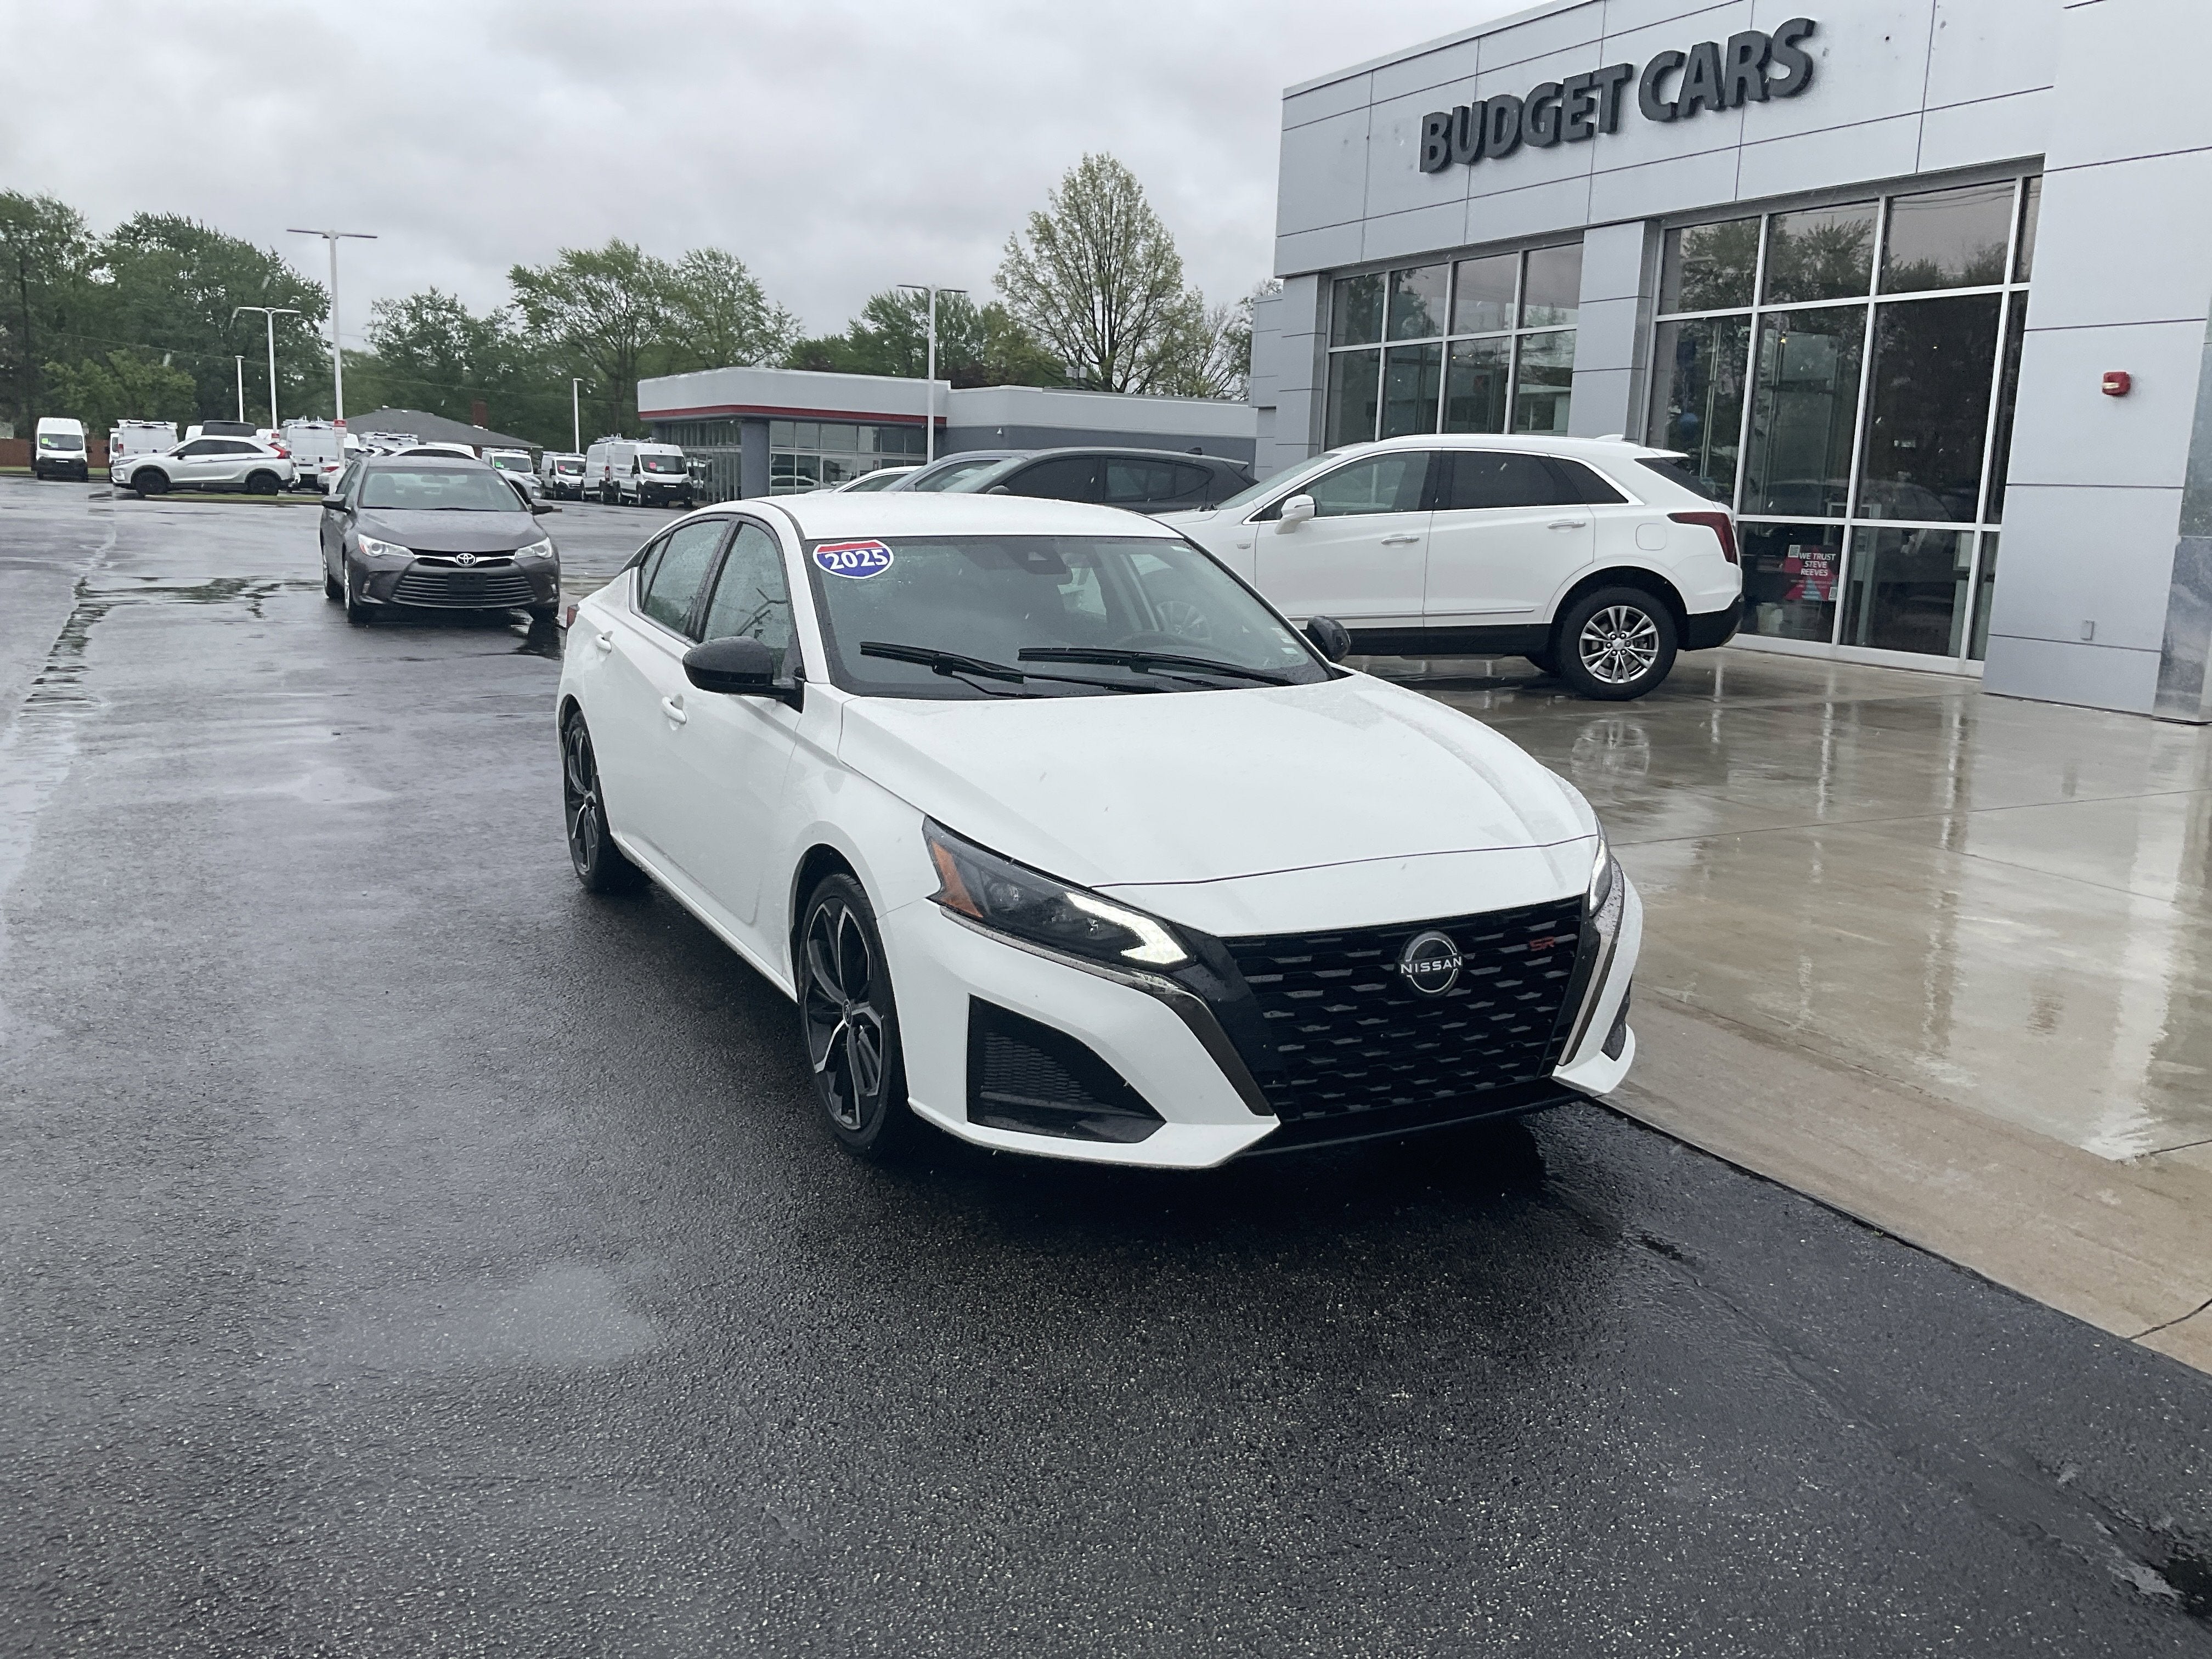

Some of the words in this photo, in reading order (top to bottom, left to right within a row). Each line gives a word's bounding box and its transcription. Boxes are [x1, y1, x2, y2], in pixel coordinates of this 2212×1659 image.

[1419, 63, 1633, 173] BUDGET
[1638, 17, 1816, 122] CARS
[825, 549, 888, 570] 2025
[1400, 956, 1463, 975] NISSAN
